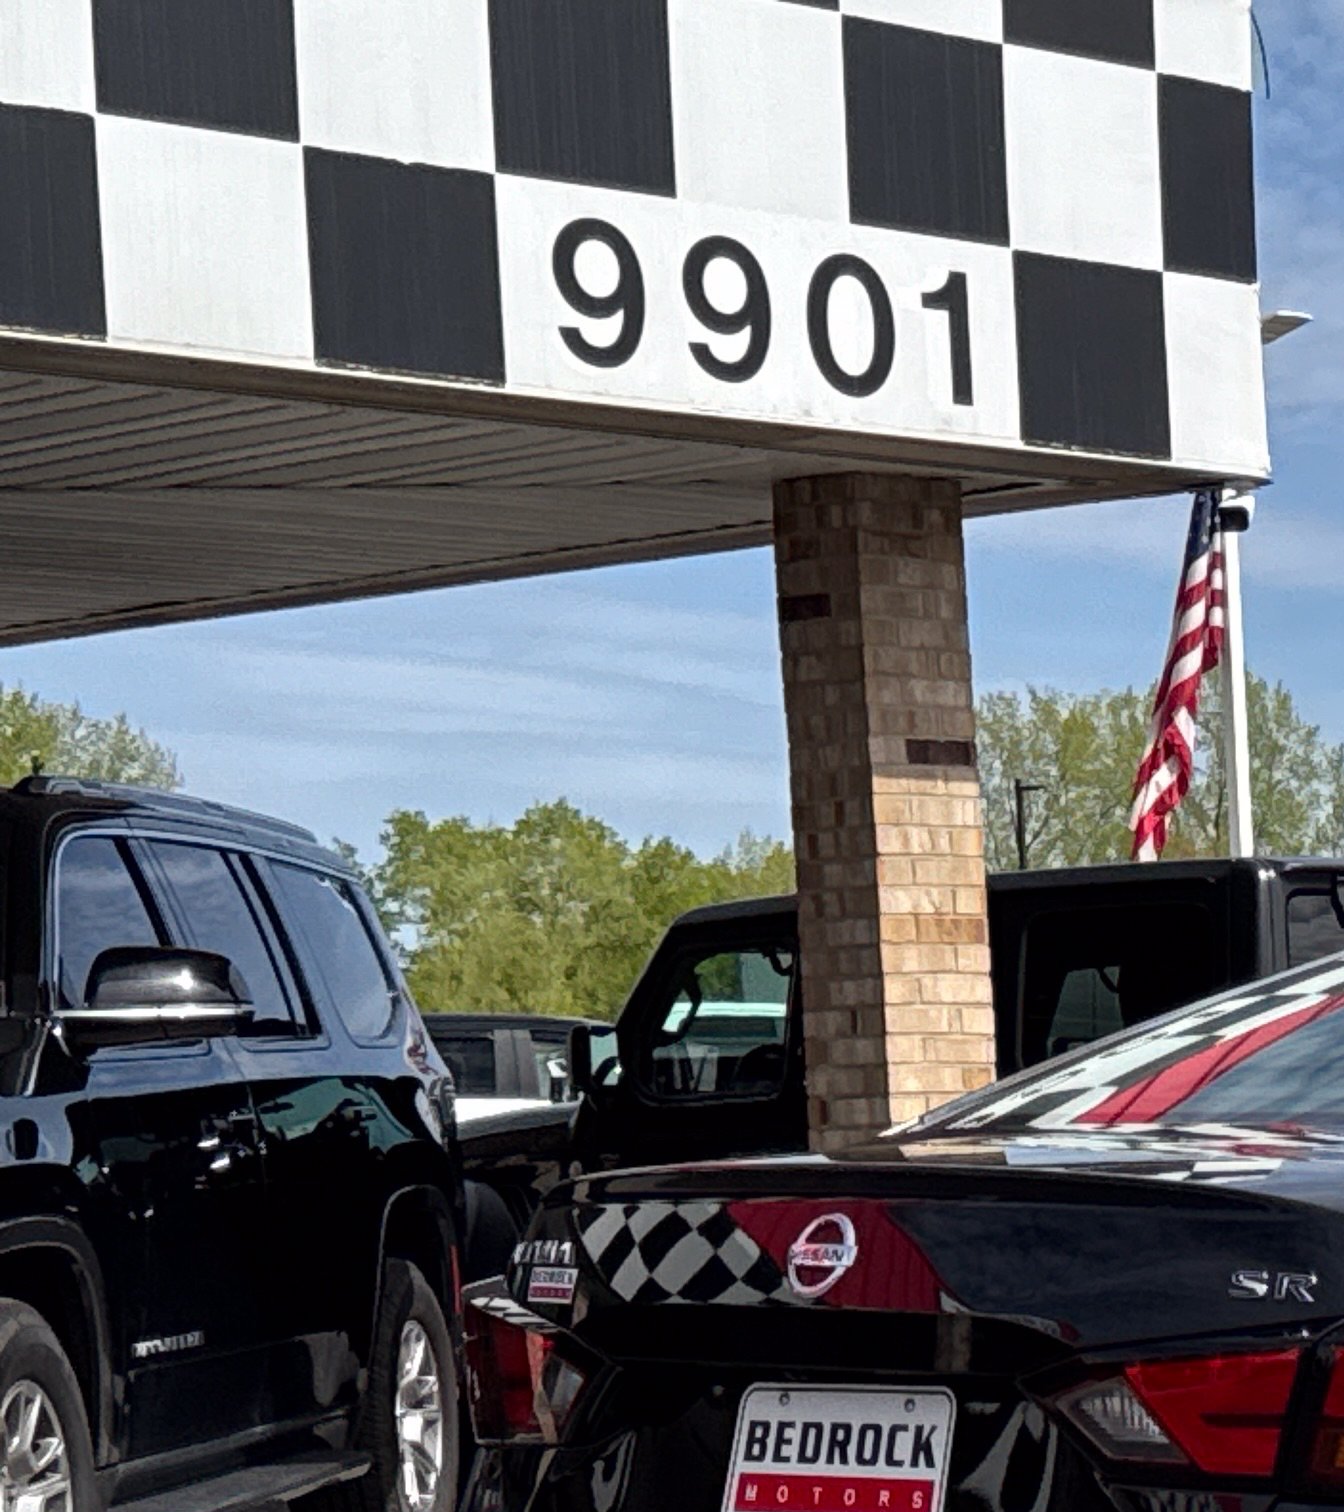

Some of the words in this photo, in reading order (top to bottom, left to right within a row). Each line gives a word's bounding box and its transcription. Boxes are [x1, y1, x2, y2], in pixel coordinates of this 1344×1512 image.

[552, 217, 974, 406] 9901
[1228, 1268, 1318, 1303] SR
[743, 1419, 938, 1469] BEDROCK
[744, 1484, 924, 1510] MOTORS
